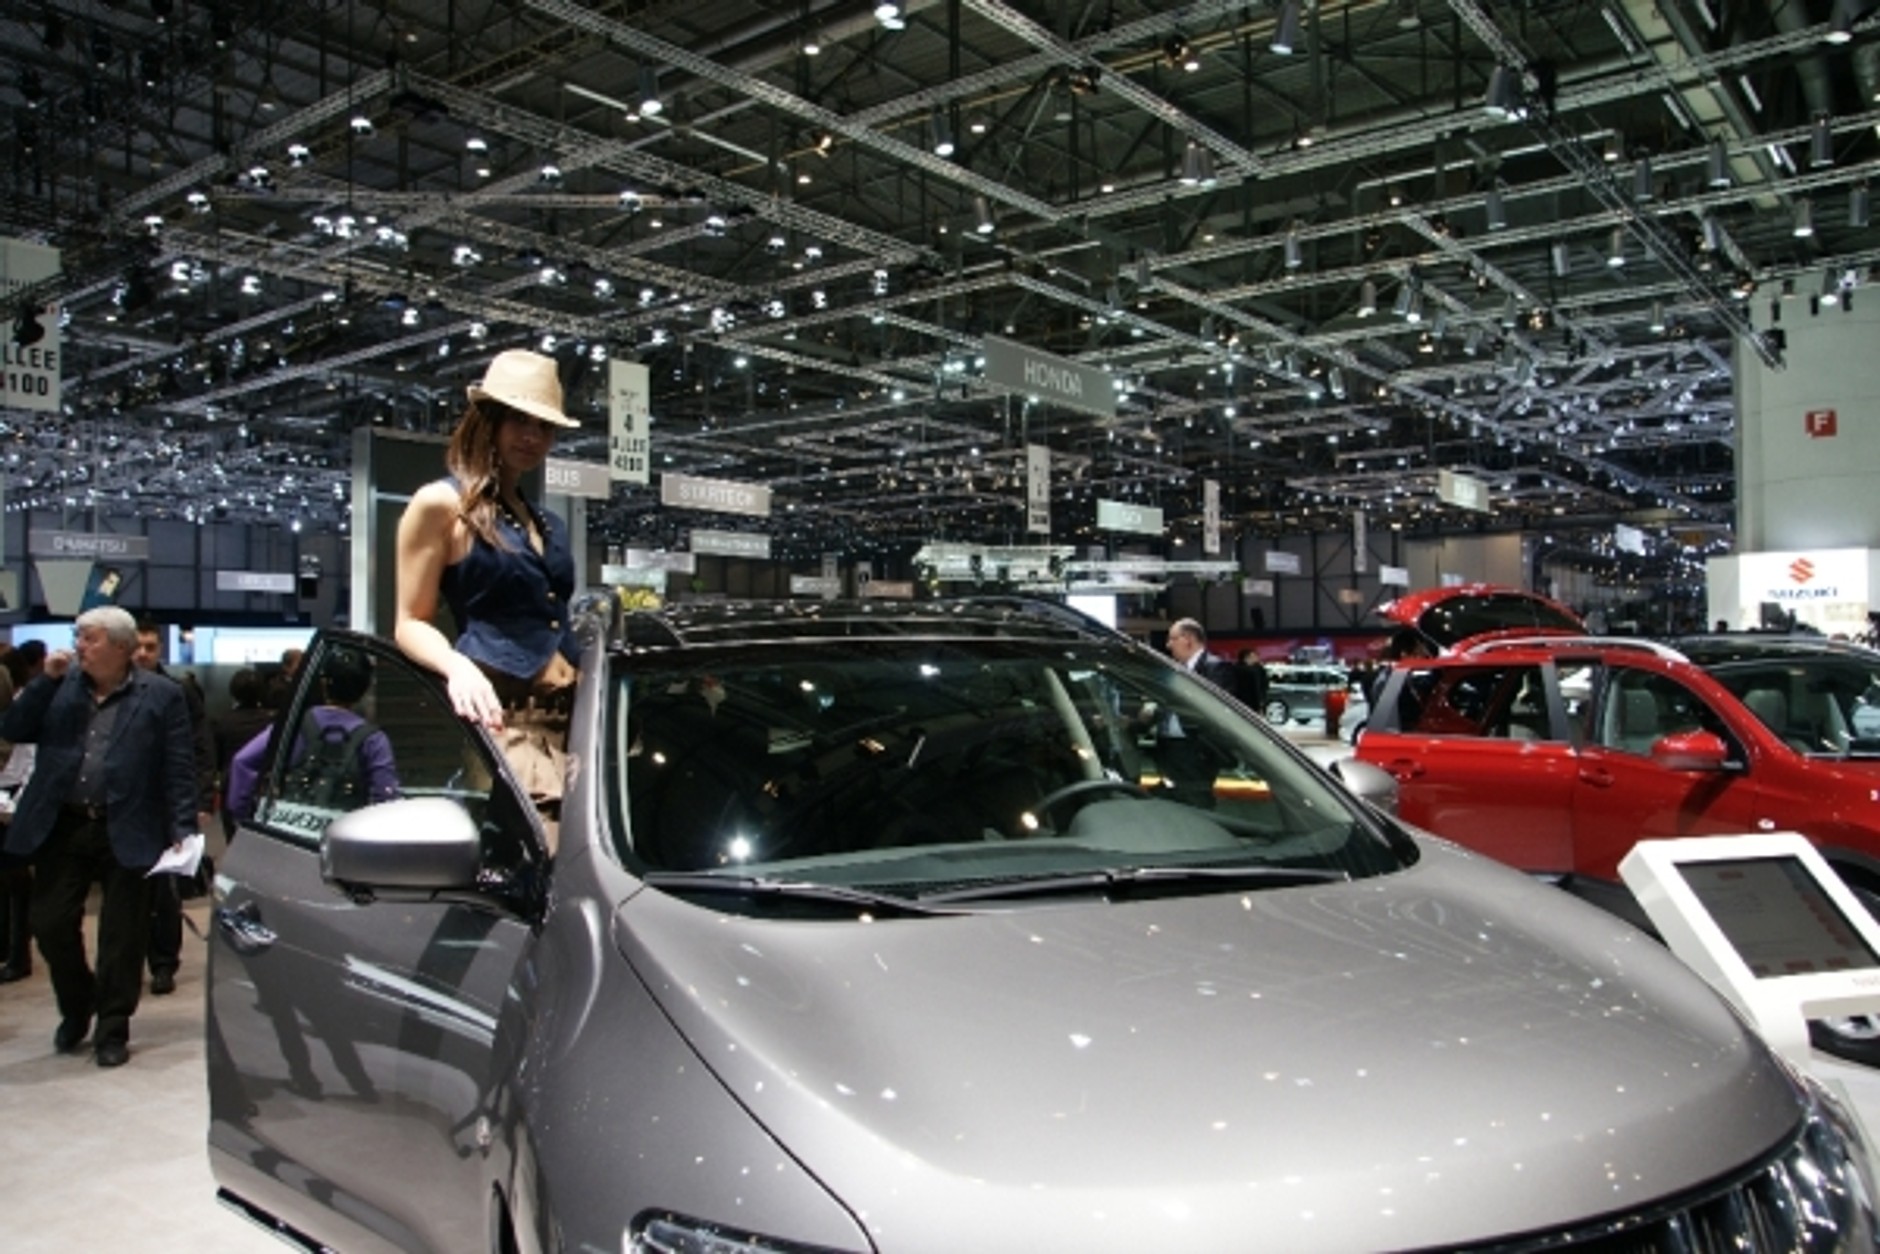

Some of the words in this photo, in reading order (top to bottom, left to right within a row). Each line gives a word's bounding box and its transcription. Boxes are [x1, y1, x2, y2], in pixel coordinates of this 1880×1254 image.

[1023, 357, 1082, 398] HONDA
[1814, 412, 1829, 431] F
[545, 466, 581, 487] BUS
